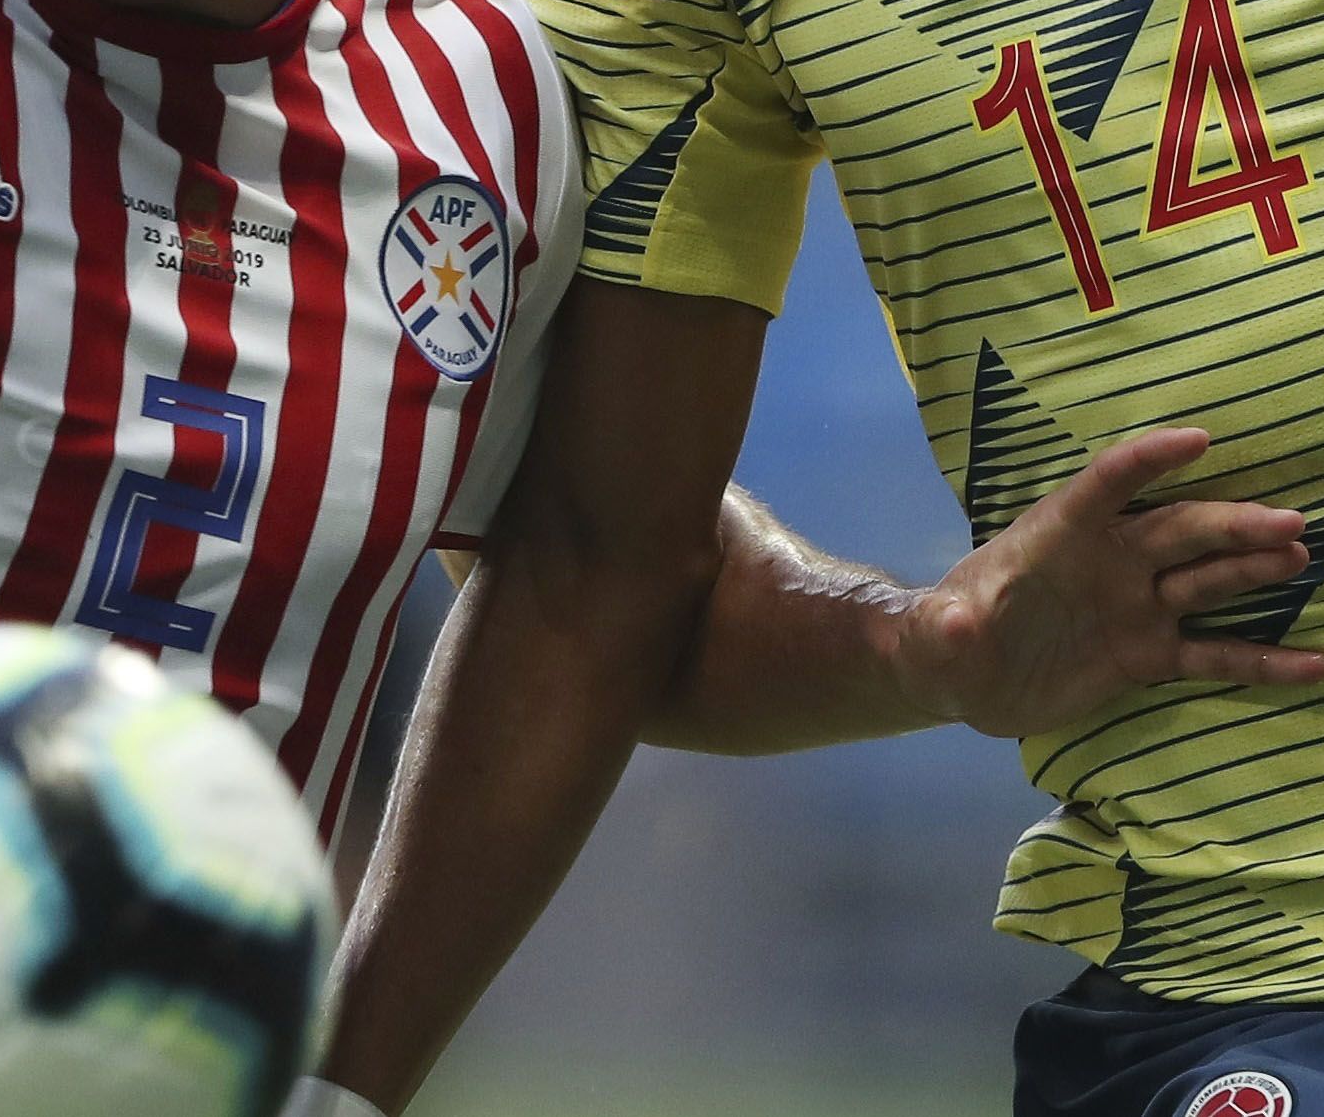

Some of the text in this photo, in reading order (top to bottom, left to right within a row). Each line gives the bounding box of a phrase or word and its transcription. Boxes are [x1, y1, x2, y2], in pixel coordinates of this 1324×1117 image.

[428, 195, 476, 228] APF
[142, 226, 162, 244] 23
[425, 337, 479, 366] PARAGUAY
[74, 374, 268, 654] 2
